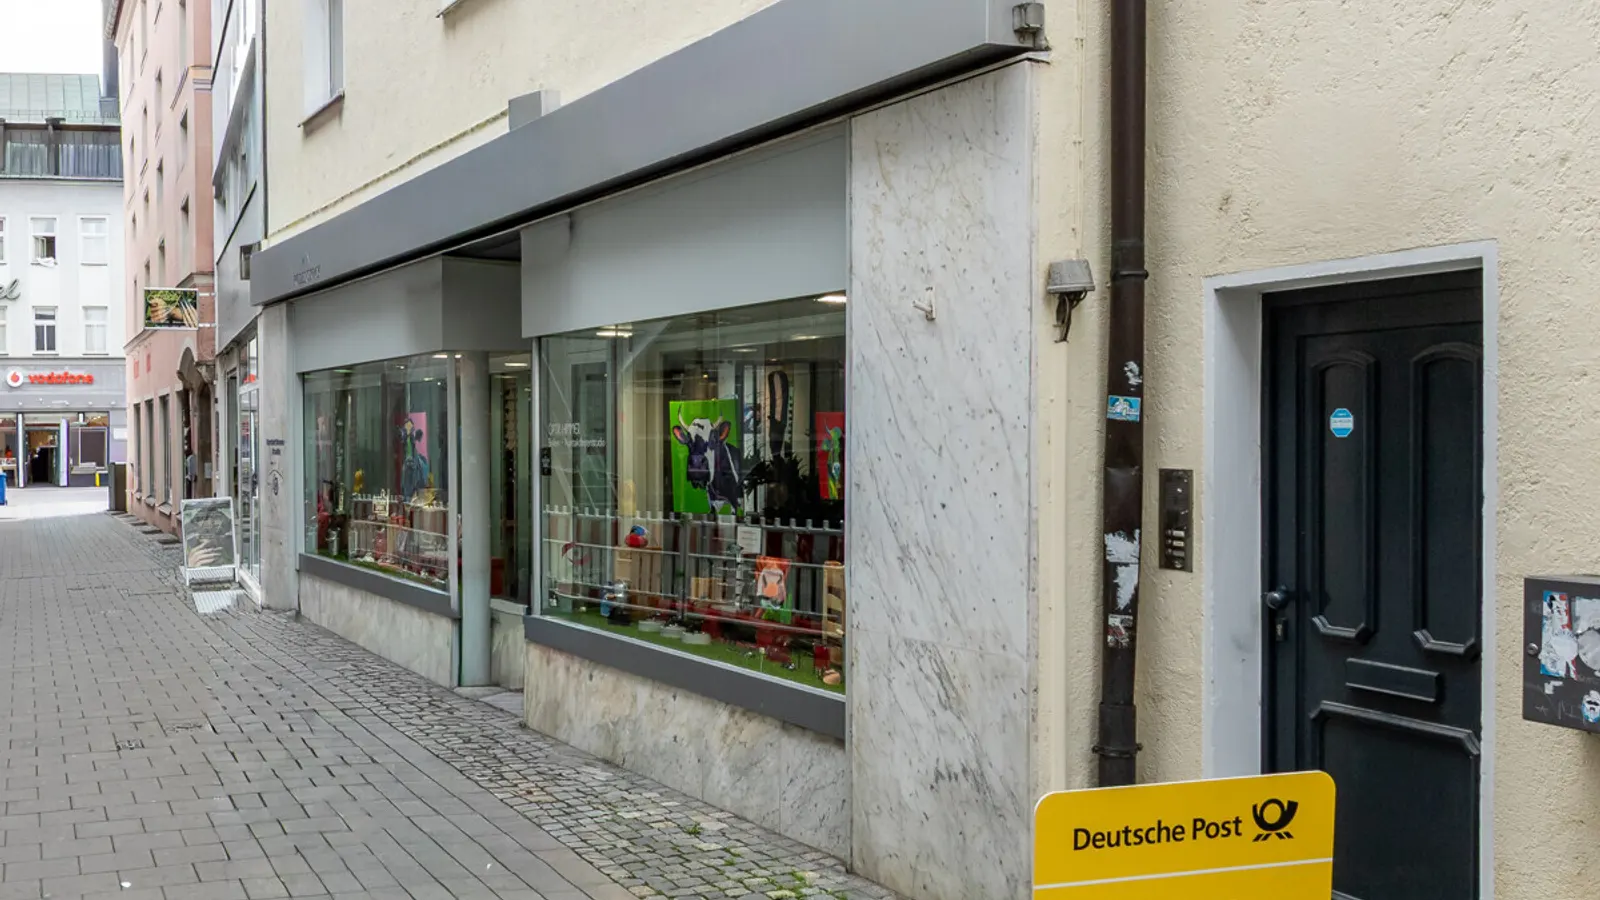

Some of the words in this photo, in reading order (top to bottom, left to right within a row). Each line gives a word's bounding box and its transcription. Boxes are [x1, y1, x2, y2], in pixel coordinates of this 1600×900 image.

[28, 371, 95, 385] vodafone
[1073, 820, 1185, 850] Deutsche
[1192, 816, 1242, 840] Post
